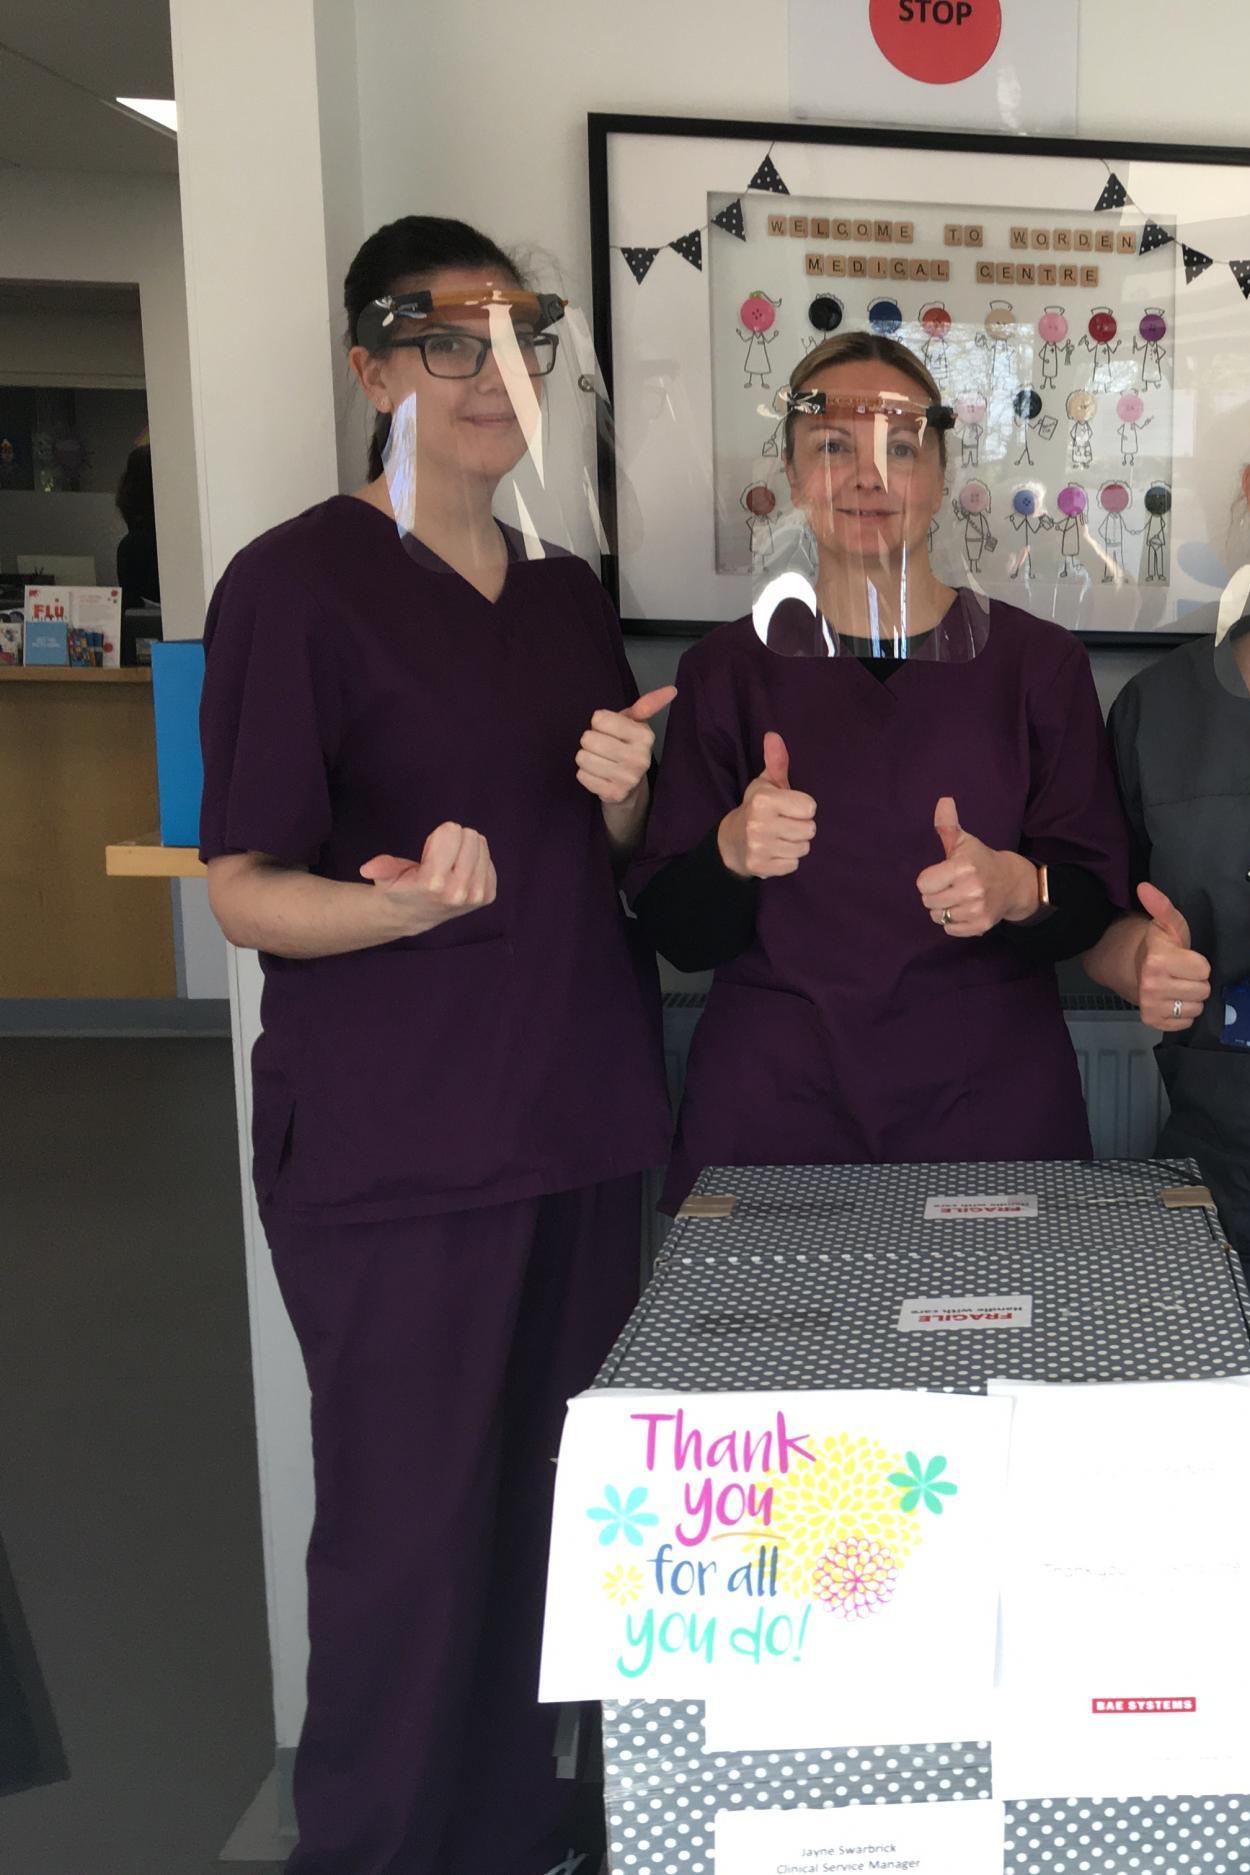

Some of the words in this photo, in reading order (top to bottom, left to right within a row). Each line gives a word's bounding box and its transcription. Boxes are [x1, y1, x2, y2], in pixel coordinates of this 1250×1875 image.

[899, 0, 972, 25] STOP
[770, 219, 911, 241] WELCOME
[947, 227, 981, 244] TO
[1011, 230, 1133, 249] WORDEN
[807, 257, 947, 278] MEDICAL
[979, 265, 1097, 284] CENTRE
[33, 604, 64, 618] FLU
[941, 1206, 1022, 1214] FRAGILE
[918, 1312, 1013, 1322] FRAGILE
[630, 1407, 817, 1474] Thank
[675, 1477, 774, 1547] you
[646, 1543, 717, 1596] for
[726, 1544, 778, 1597] all
[616, 1607, 717, 1678] you
[728, 1603, 812, 1664] do!
[1096, 1701, 1124, 1711] BAE
[1127, 1700, 1193, 1711] SYSTEMS
[802, 1848, 835, 1858] Jayne
[838, 1843, 897, 1856] Swarbrick
[776, 1863, 818, 1874] Clinical
[823, 1862, 864, 1873] Service
[868, 1859, 920, 1870] Manager
